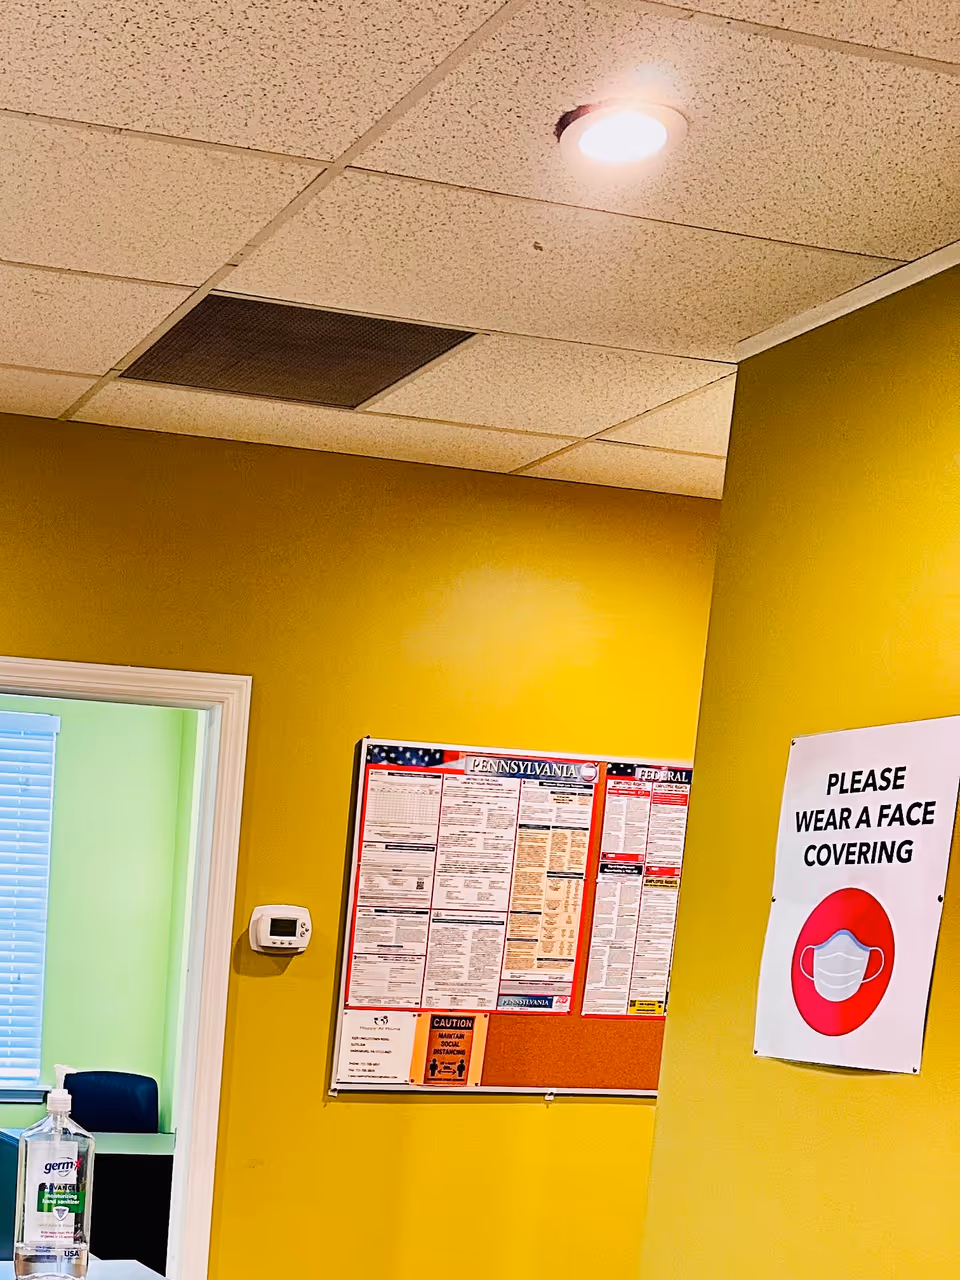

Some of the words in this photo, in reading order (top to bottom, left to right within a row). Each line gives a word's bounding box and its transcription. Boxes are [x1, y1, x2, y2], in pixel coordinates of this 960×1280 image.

[470, 758, 578, 779] PENNSYLVANIA
[638, 769, 689, 783] FEDERAL
[826, 766, 907, 796] PLEASE
[795, 807, 852, 833] WEAR
[854, 807, 871, 830] A
[876, 801, 937, 828] FACE
[803, 839, 914, 867] COVERING
[433, 1018, 473, 1027] CAUTION
[438, 1032, 465, 1040] MAINTAIN
